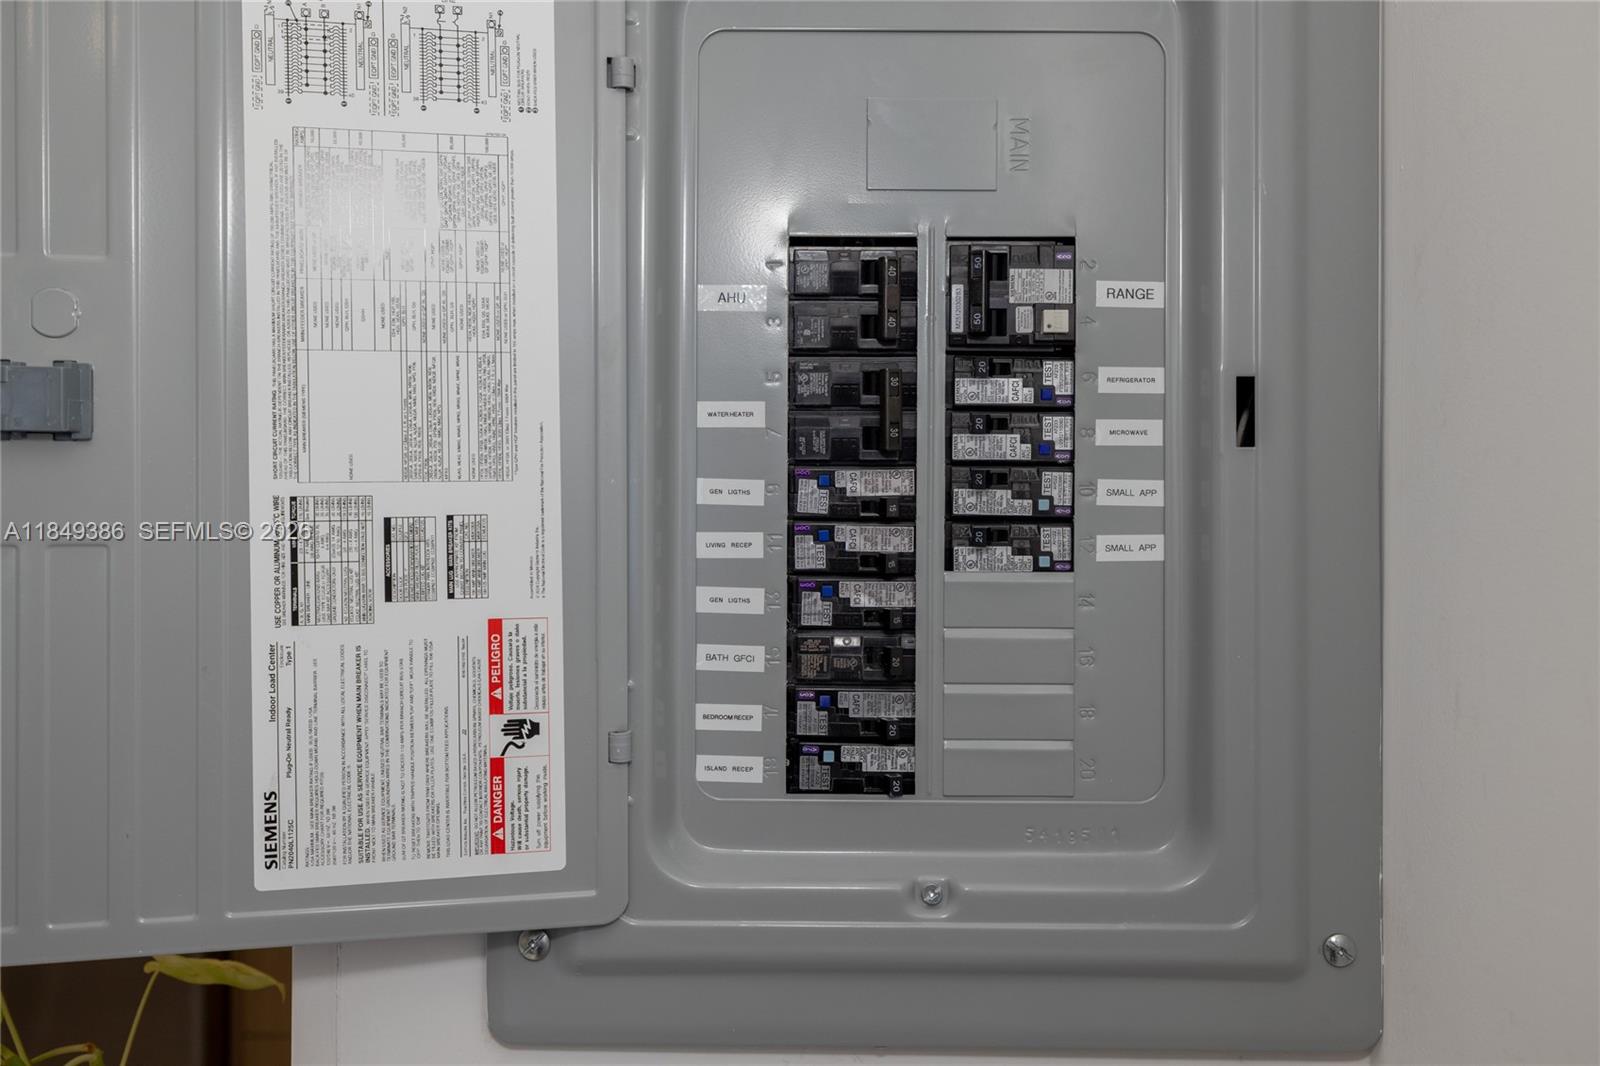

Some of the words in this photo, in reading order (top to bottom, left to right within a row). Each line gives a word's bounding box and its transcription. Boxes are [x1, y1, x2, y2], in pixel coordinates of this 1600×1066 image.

[1009, 118, 1030, 172] MAIN
[975, 257, 981, 268] 50
[888, 266, 896, 276] 40
[718, 292, 746, 303] AHU
[1107, 288, 1155, 300] RANGE
[888, 317, 896, 327] 40
[974, 314, 980, 324] 50
[979, 361, 986, 372] 20
[890, 377, 898, 386] 30
[976, 418, 983, 429] 20
[890, 428, 898, 437] 30
[849, 473, 857, 493] CAFCI
[976, 474, 983, 484] 20
[819, 491, 827, 512] TEST
[976, 531, 983, 542] 20
[274, 576, 280, 585] OR
[491, 634, 500, 683] PELIGRO
[892, 658, 900, 667] 20
[889, 725, 896, 736] 20
[1080, 758, 1096, 782] 20
[893, 781, 900, 792] 20
[357, 793, 363, 802] AS
[493, 776, 502, 823] DANGER
[264, 791, 277, 869] SIEMENS
